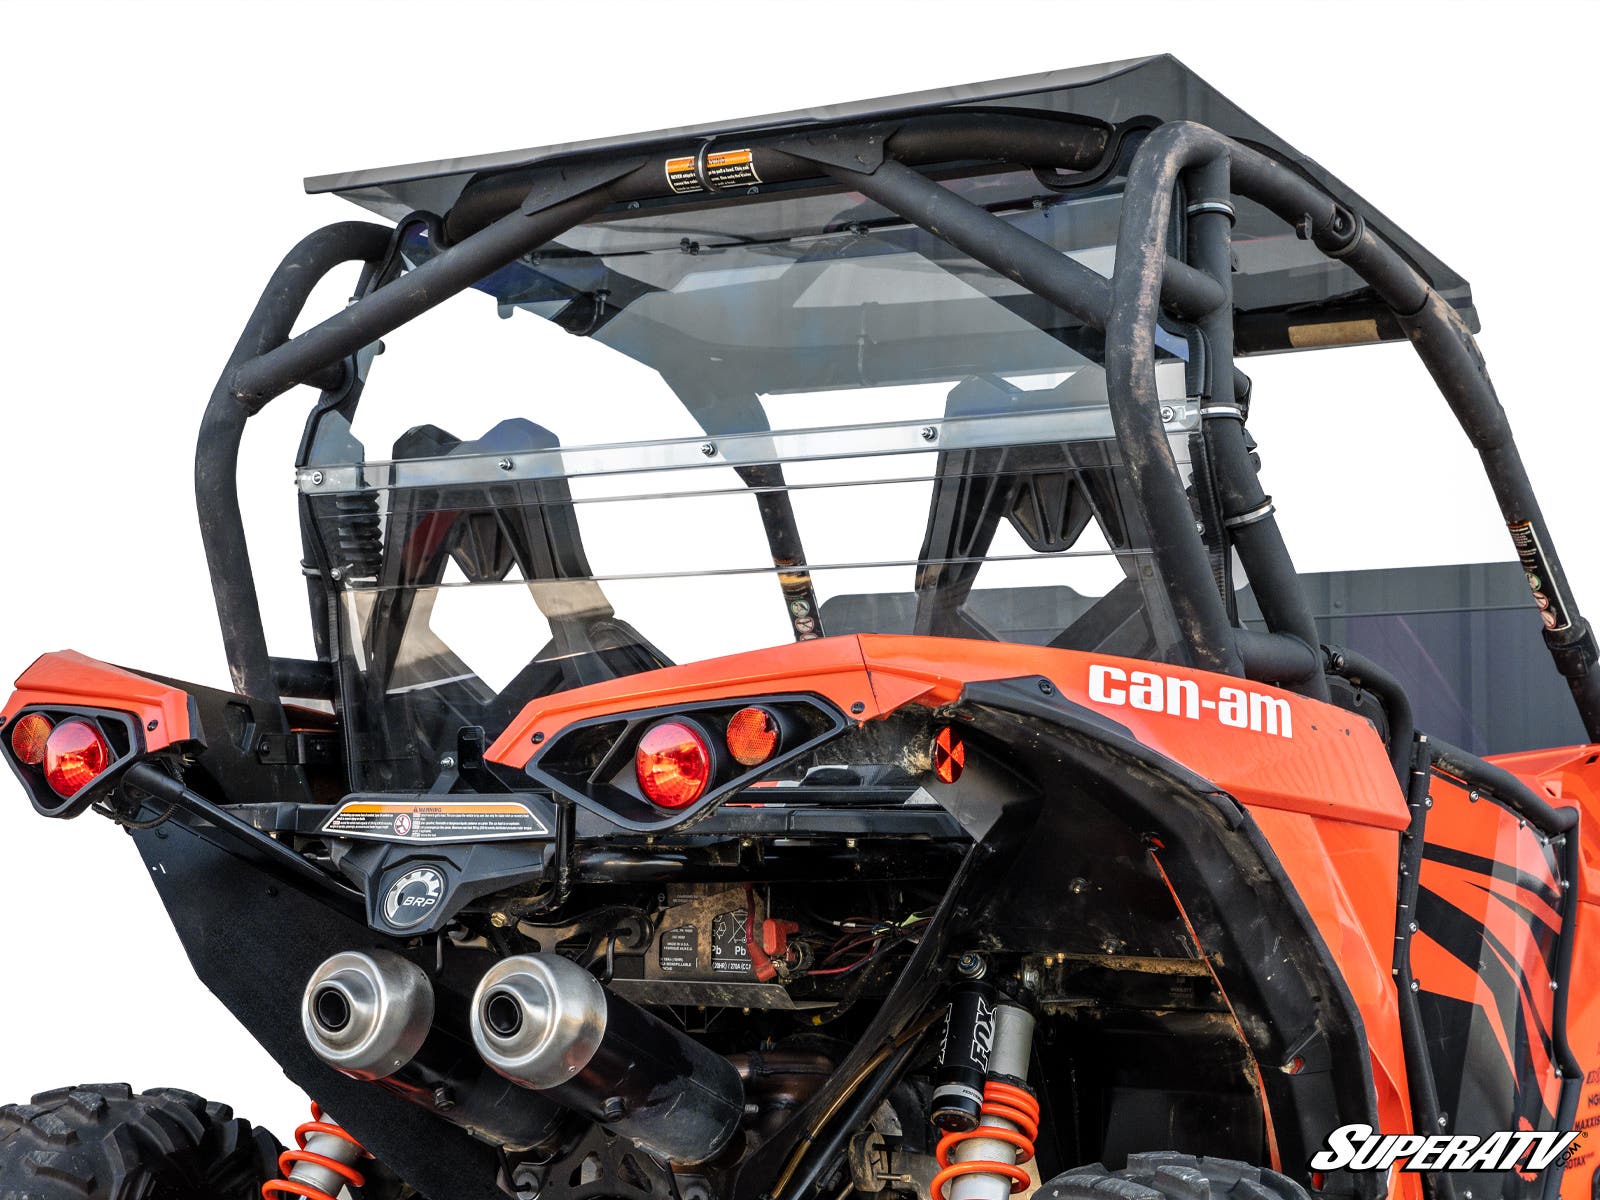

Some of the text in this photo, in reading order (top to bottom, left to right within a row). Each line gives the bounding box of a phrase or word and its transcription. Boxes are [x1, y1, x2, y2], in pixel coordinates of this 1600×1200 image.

[1088, 664, 1293, 739] can-am
[402, 896, 436, 907] BRP
[735, 945, 747, 956] Pb
[970, 996, 998, 1076] FOX
